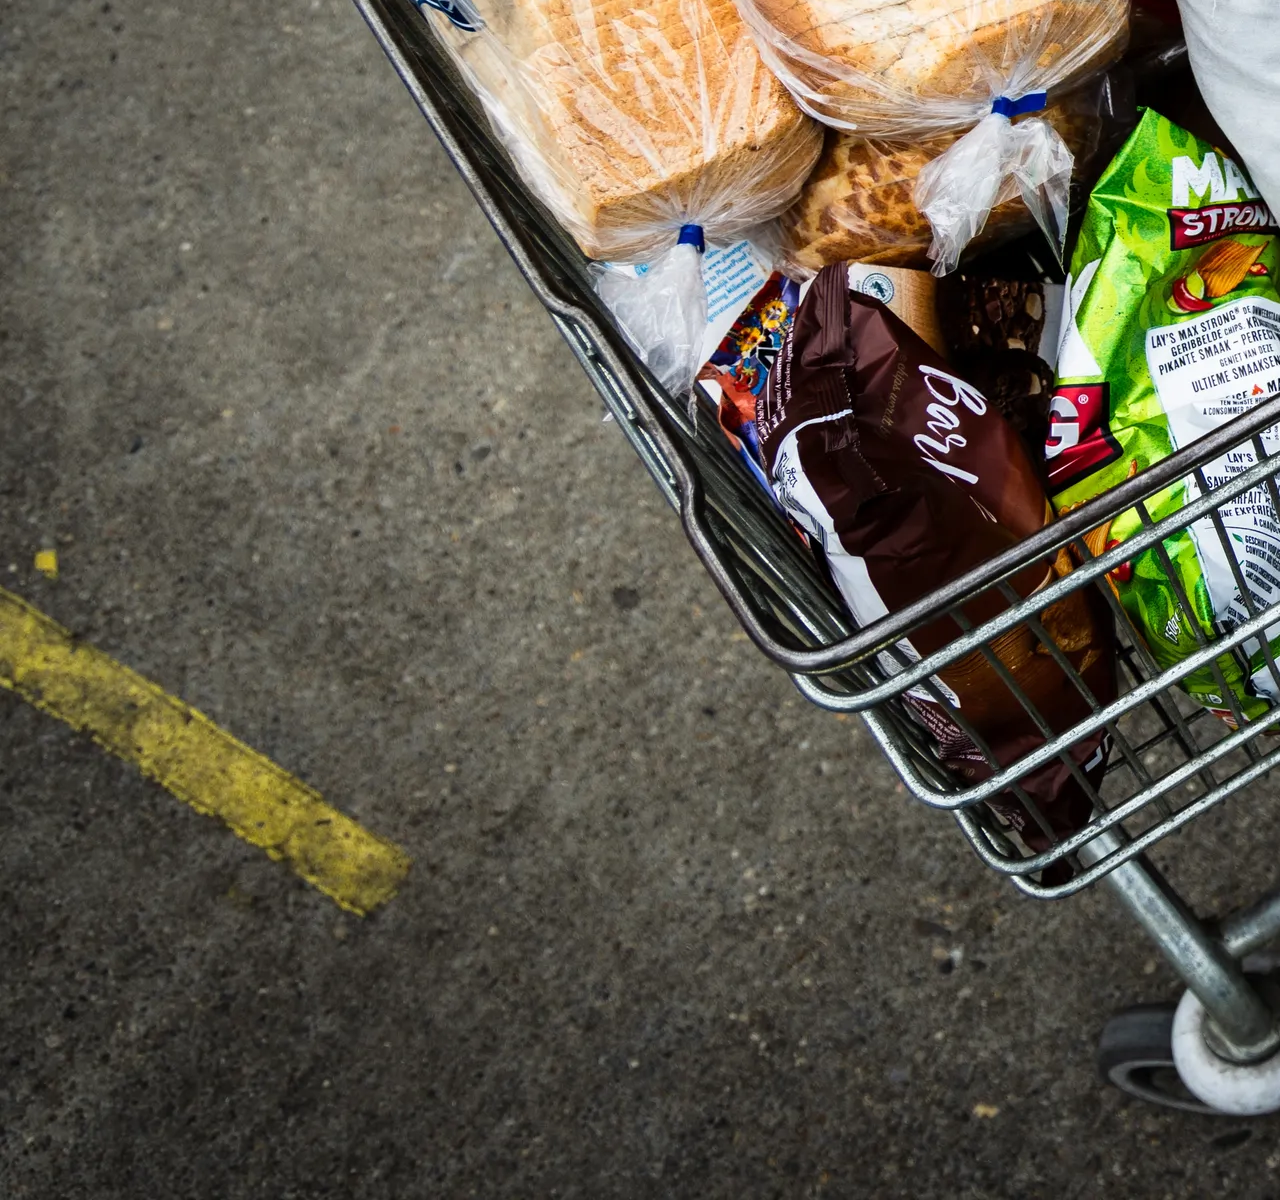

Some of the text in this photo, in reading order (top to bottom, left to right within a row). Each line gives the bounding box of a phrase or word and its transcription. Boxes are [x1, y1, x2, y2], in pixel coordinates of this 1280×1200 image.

[1172, 152, 1260, 206] MA
[716, 253, 747, 279] PlanetProof
[1151, 333, 1176, 348] LAY'S
[1178, 327, 1199, 340] MAX
[1243, 306, 1251, 314] DE
[1171, 330, 1223, 357] GERIBBELDE
[1224, 323, 1246, 336] CHIPS.
[1159, 353, 1197, 375] PIKANTE
[1199, 341, 1232, 360] SMAAK
[1241, 330, 1275, 345] PERFECT
[1219, 344, 1274, 367] GENIET VAN DEZE
[1192, 371, 1231, 393] ULTIEME
[1208, 406, 1244, 416] CONSOMMER
[1227, 453, 1254, 463] LAY'S
